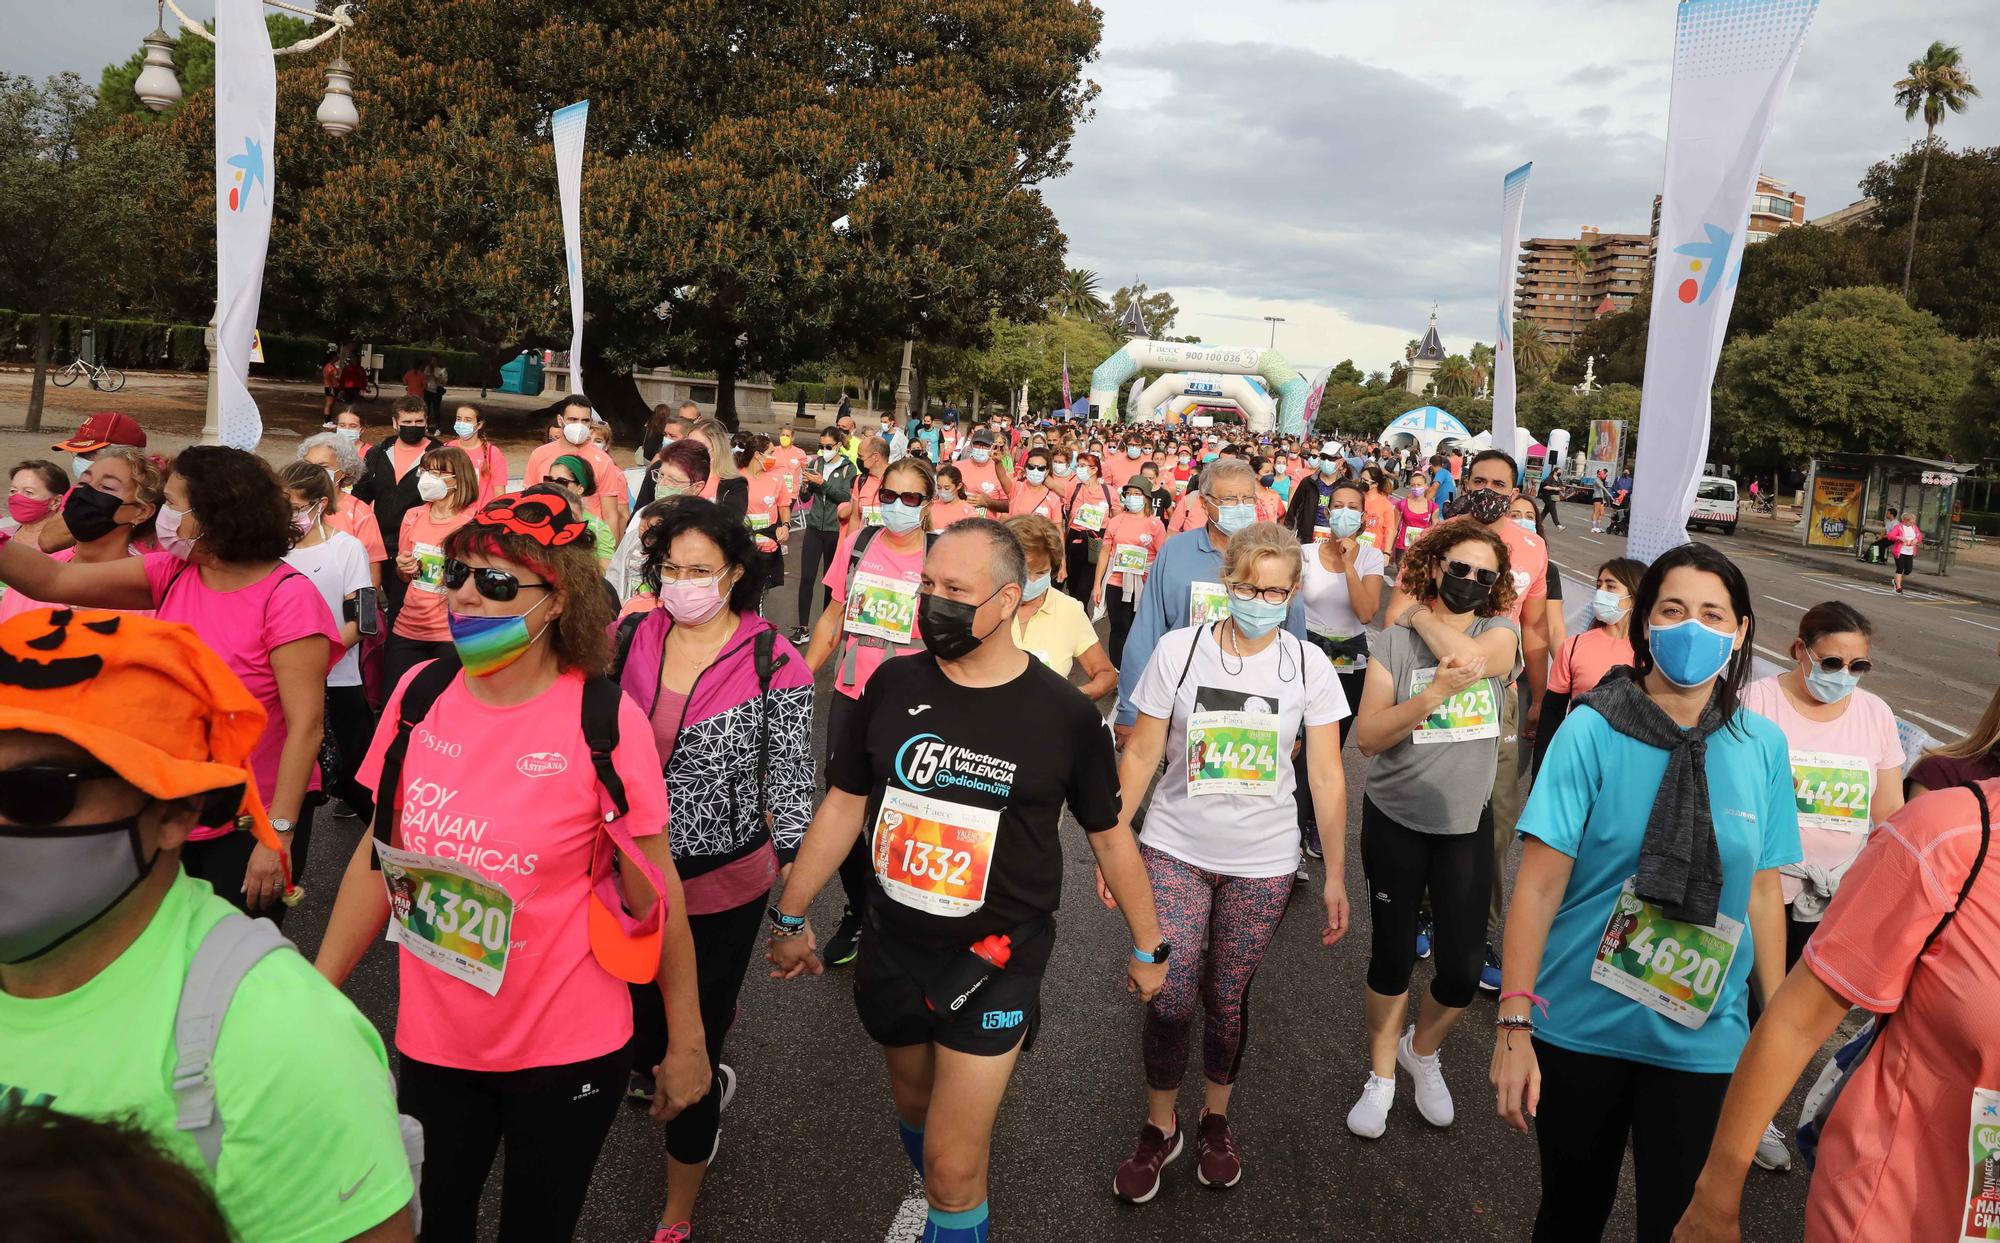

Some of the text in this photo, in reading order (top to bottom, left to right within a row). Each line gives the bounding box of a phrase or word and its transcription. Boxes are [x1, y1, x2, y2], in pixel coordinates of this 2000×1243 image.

[1185, 351, 1202, 360] 900
[1205, 353, 1222, 362] 100
[1223, 354, 1241, 363] 036
[863, 595, 912, 626] 4524
[1430, 689, 1492, 720] 4423
[907, 741, 1017, 785] 15K Nocturna
[954, 759, 1014, 785] VALENCIA
[1205, 741, 1275, 772] 4424
[407, 777, 459, 811] HOY
[936, 771, 1010, 798] mediolanum
[994, 781, 1012, 790] BANCO
[1797, 779, 1866, 809] 4422
[401, 800, 488, 844] GANAN
[433, 840, 539, 877] CHICAS
[901, 839, 972, 887] 1332
[416, 881, 507, 951] 4320
[1628, 926, 1722, 997] 4620
[1981, 1157, 1997, 1199] RUN AECC
